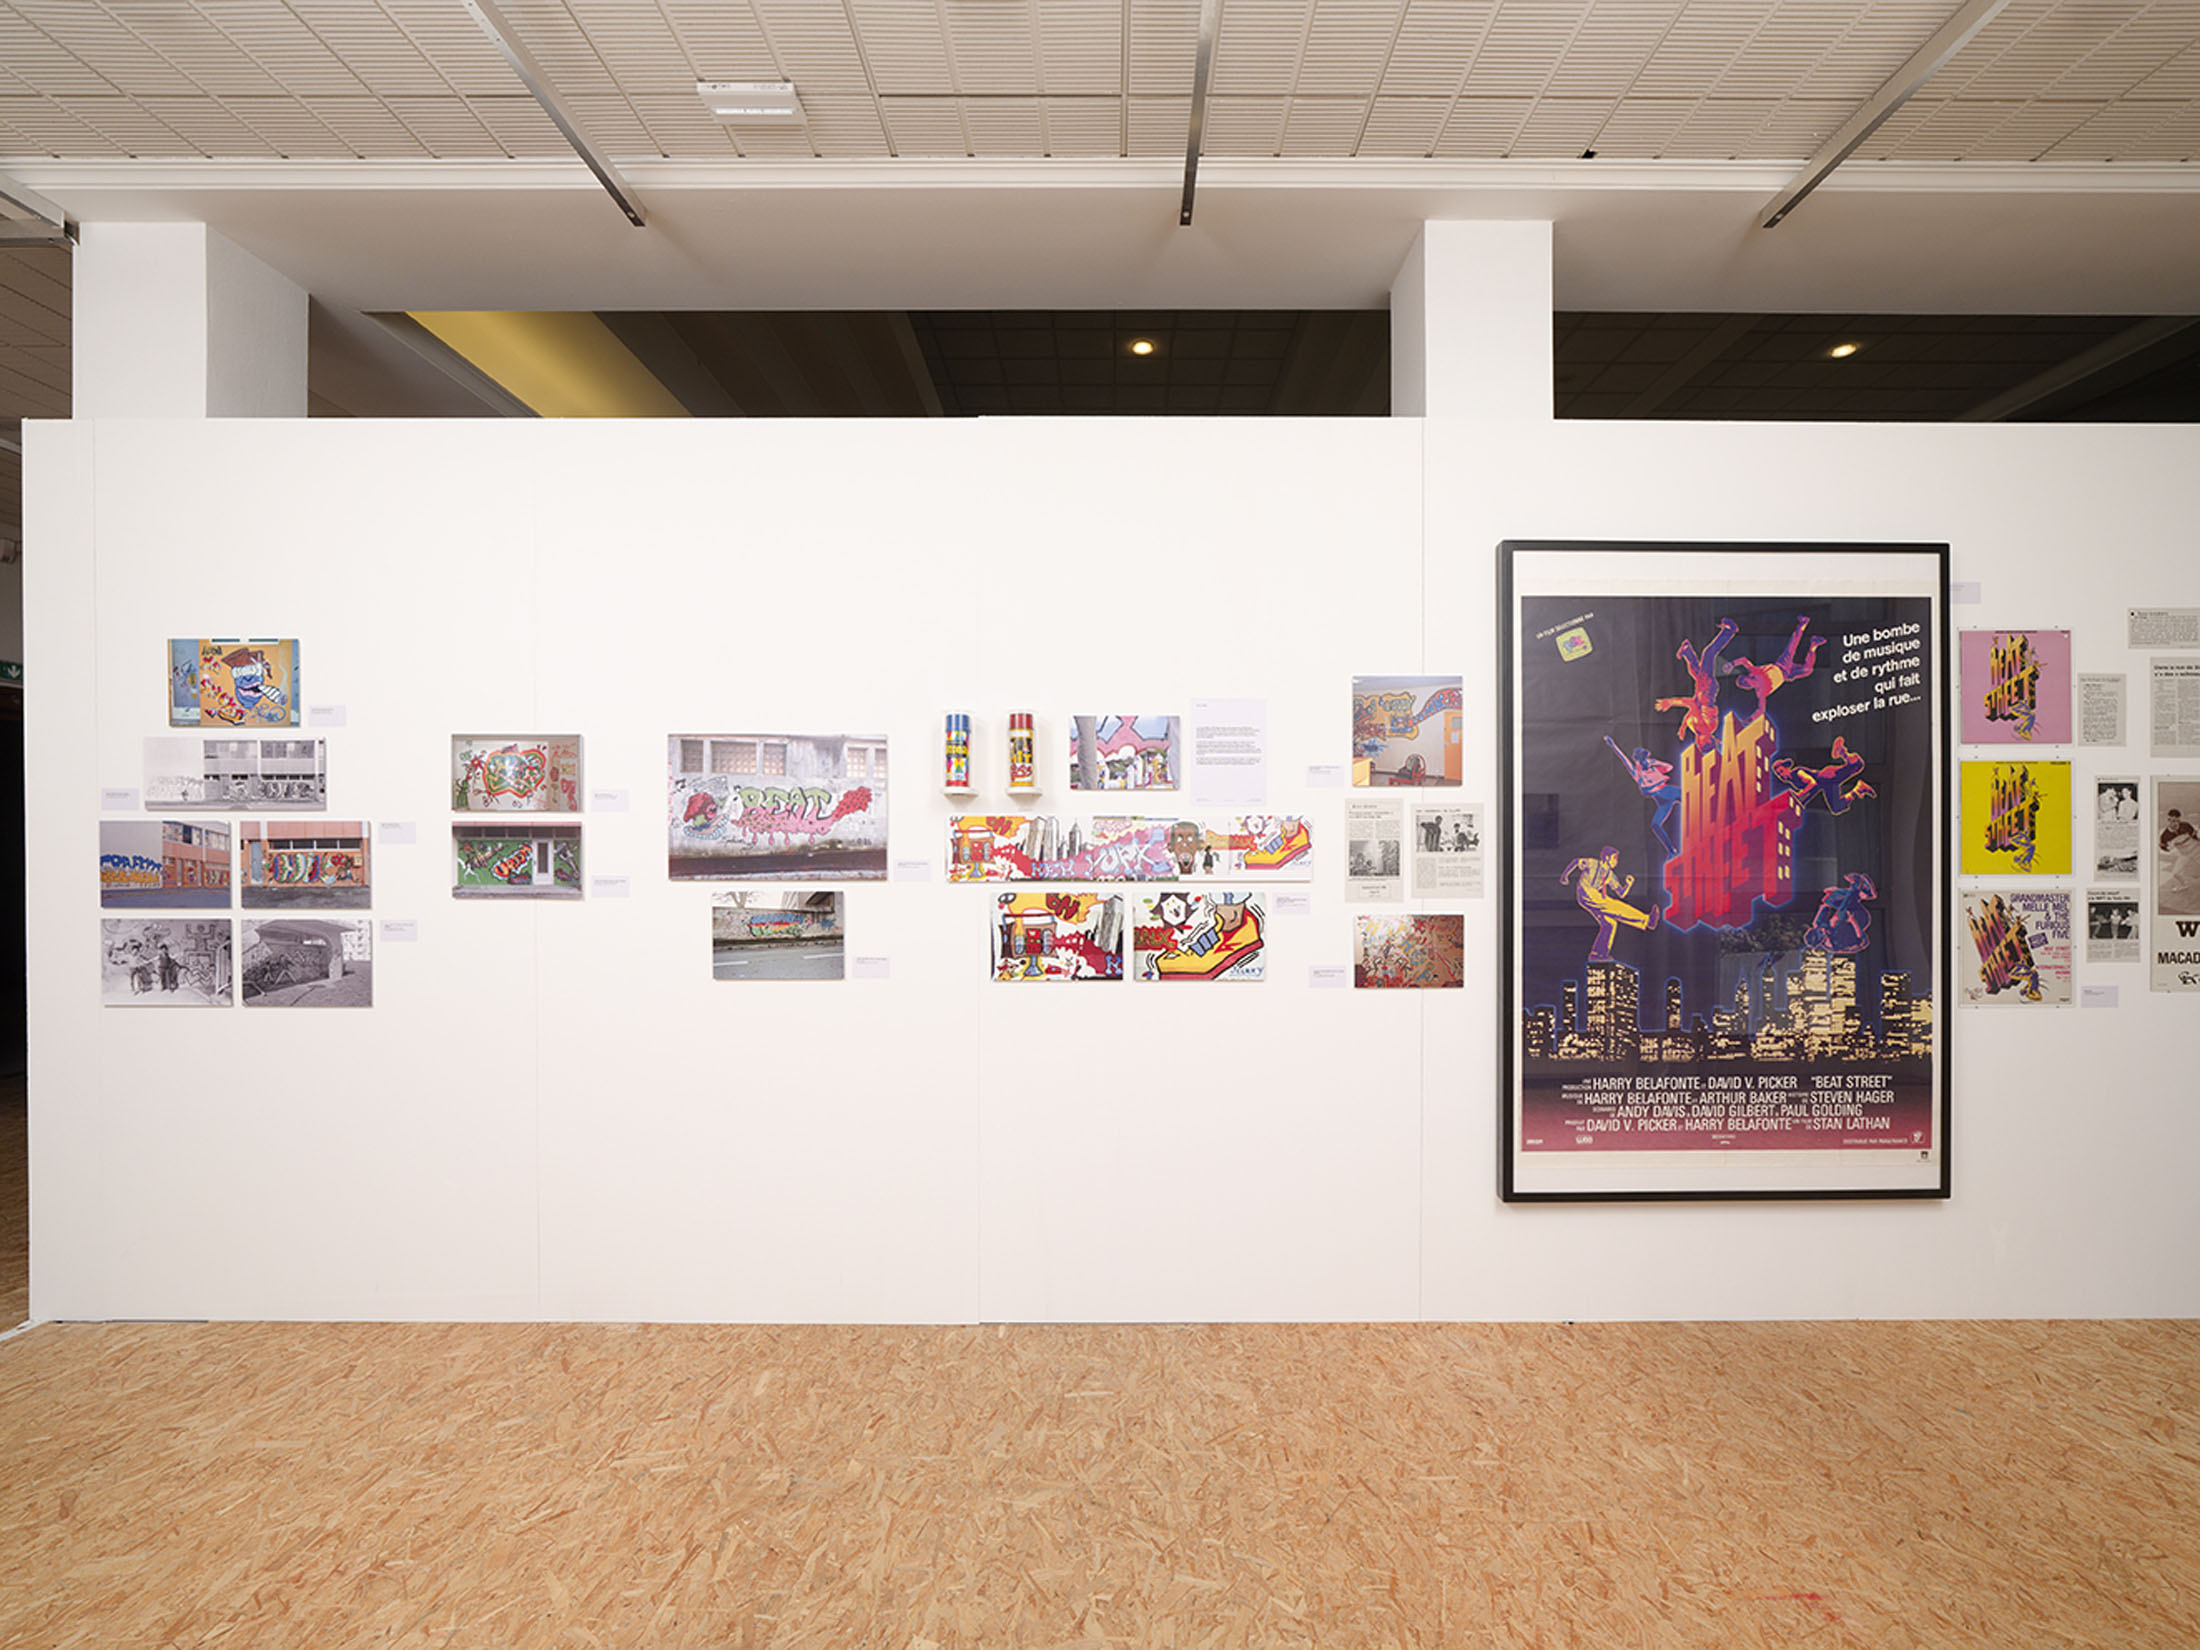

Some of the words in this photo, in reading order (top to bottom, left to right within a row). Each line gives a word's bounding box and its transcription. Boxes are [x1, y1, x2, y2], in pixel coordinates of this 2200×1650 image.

[1843, 633, 1870, 647] Une
[1873, 623, 1920, 641] bombe
[1842, 650, 1861, 664] de
[1864, 639, 1920, 655] musique
[1833, 670, 1848, 683] et
[1850, 666, 1868, 680] de
[1872, 657, 1920, 677] rythme
[1874, 676, 1896, 694] qui
[1899, 673, 1920, 687] fait
[1812, 701, 1871, 722] exploser
[1873, 697, 1885, 709] la
[1889, 693, 1921, 706] rue...
[1681, 711, 1770, 856] BEAT
[1664, 790, 1796, 924] STREET
[2010, 893, 2070, 903] GRANDMASTER
[2175, 921, 2200, 937] W
[2158, 952, 2200, 964] MACAD
[1592, 1077, 1632, 1090] HARRY
[1635, 1077, 1700, 1090] BELAFONTE
[1708, 1077, 1742, 1090] DAVID
[1744, 1077, 1755, 1089] V.
[1758, 1076, 1798, 1089] PICKER
[1811, 1075, 1843, 1088] "BEAT
[1846, 1075, 1893, 1088] STREET"
[1584, 1092, 1624, 1105] HARRY
[1627, 1092, 1692, 1105] BELAFONTE
[1699, 1091, 1746, 1104] ARTHUR
[1750, 1091, 1787, 1104] BAKER
[1810, 1091, 1852, 1104] STEVEN
[1856, 1090, 1895, 1103] HAGER
[1617, 1105, 1650, 1118] ANDY
[1691, 1104, 1726, 1117] DAVID
[1780, 1104, 1809, 1117] PAUL
[1812, 1103, 1863, 1117] GOLDING
[1586, 1118, 1621, 1132] DAVID
[1623, 1118, 1635, 1131] V.
[1637, 1118, 1677, 1131] PICKER
[1685, 1118, 1725, 1131] HARRY
[1727, 1118, 1792, 1131] BELAFONTE
[1812, 1117, 1843, 1130] STAN
[1846, 1117, 1891, 1130] LATHAN
